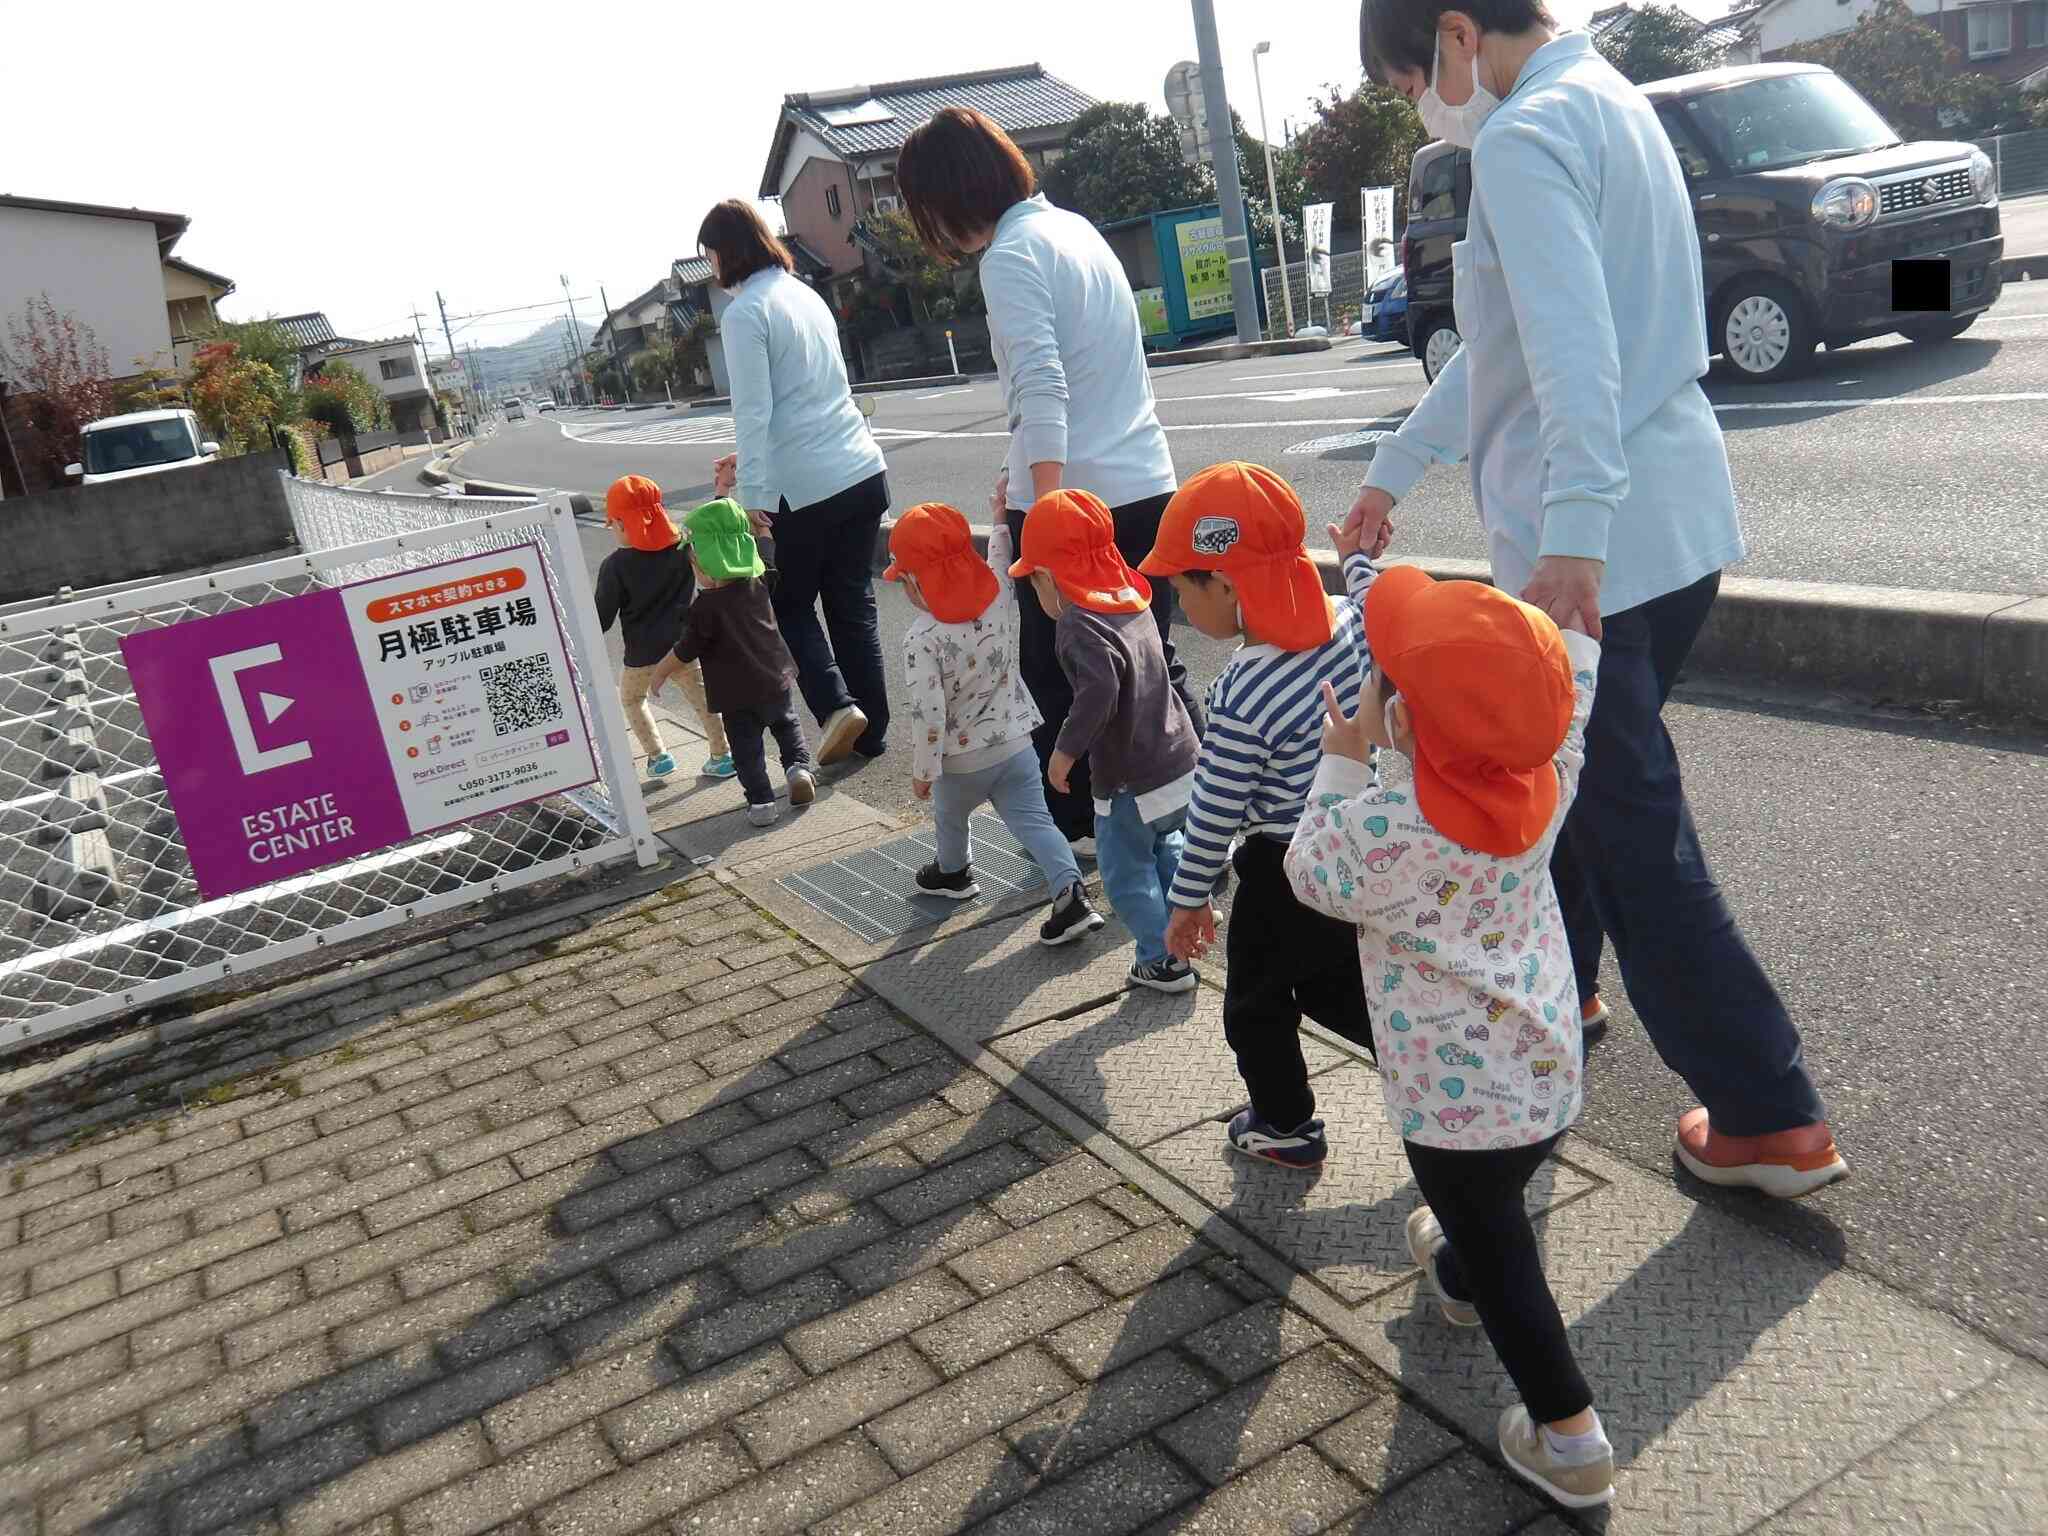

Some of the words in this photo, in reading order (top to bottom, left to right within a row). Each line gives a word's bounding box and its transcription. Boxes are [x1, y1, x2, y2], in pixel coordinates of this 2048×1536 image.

[388, 577, 508, 615] スマホで契約できる
[377, 597, 537, 663] 月極駐車場
[423, 640, 507, 672] アップル駐車場
[412, 765, 435, 781] Park
[436, 758, 467, 774] Direct
[465, 761, 538, 790] 050-3173-9036
[241, 793, 338, 839] ESTATE
[248, 816, 356, 863] CENTER
